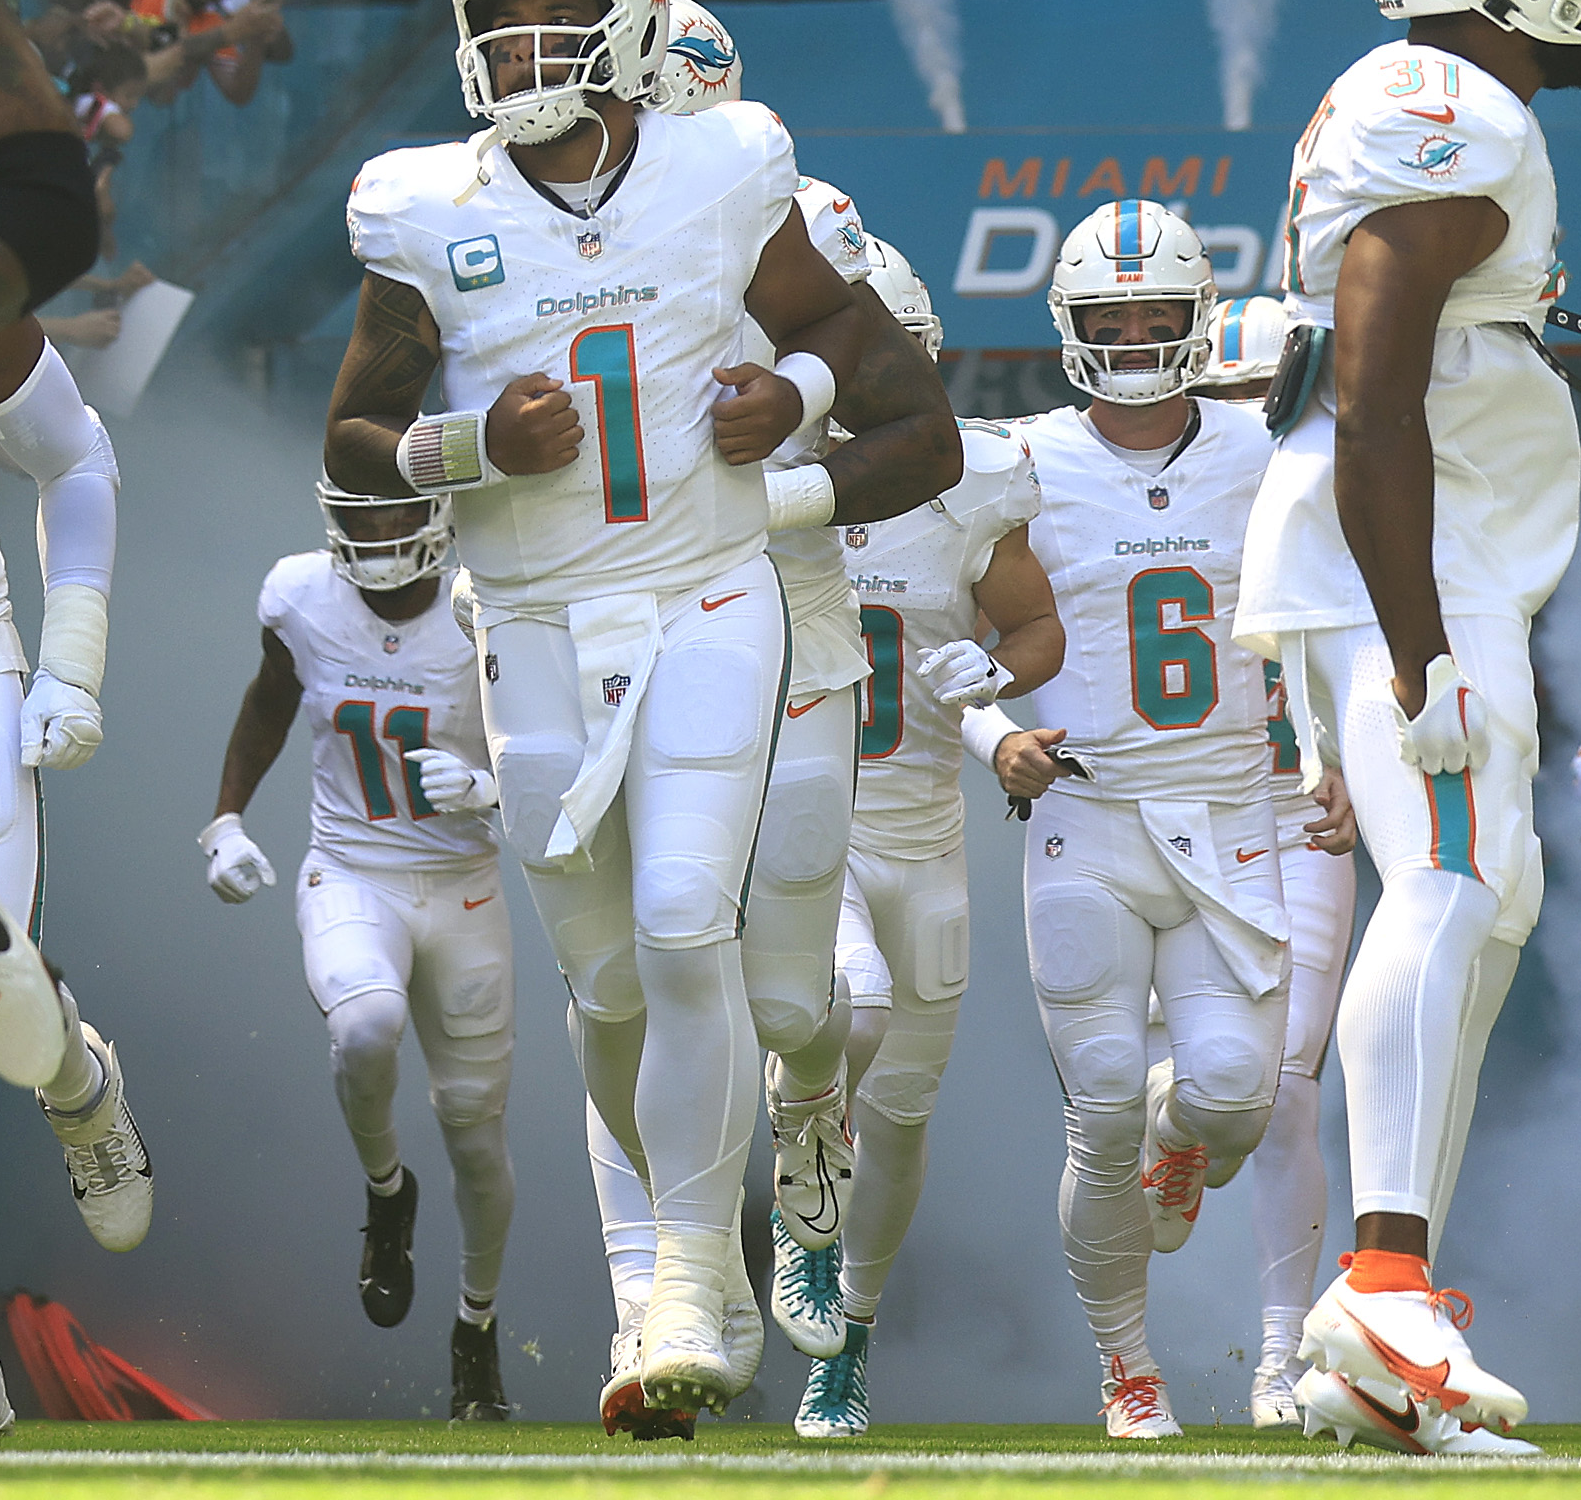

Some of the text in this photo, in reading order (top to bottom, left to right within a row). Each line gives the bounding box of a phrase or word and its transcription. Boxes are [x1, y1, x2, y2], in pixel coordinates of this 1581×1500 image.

[1379, 59, 1462, 98] 31
[978, 156, 1232, 199] MIAMI
[452, 238, 499, 279] C
[536, 285, 658, 318] Dolphins
[569, 323, 649, 524] 1
[1114, 536, 1211, 558] Dolphins
[1126, 565, 1219, 731] 6
[344, 674, 426, 696] Dolphins
[332, 699, 441, 822] 11
